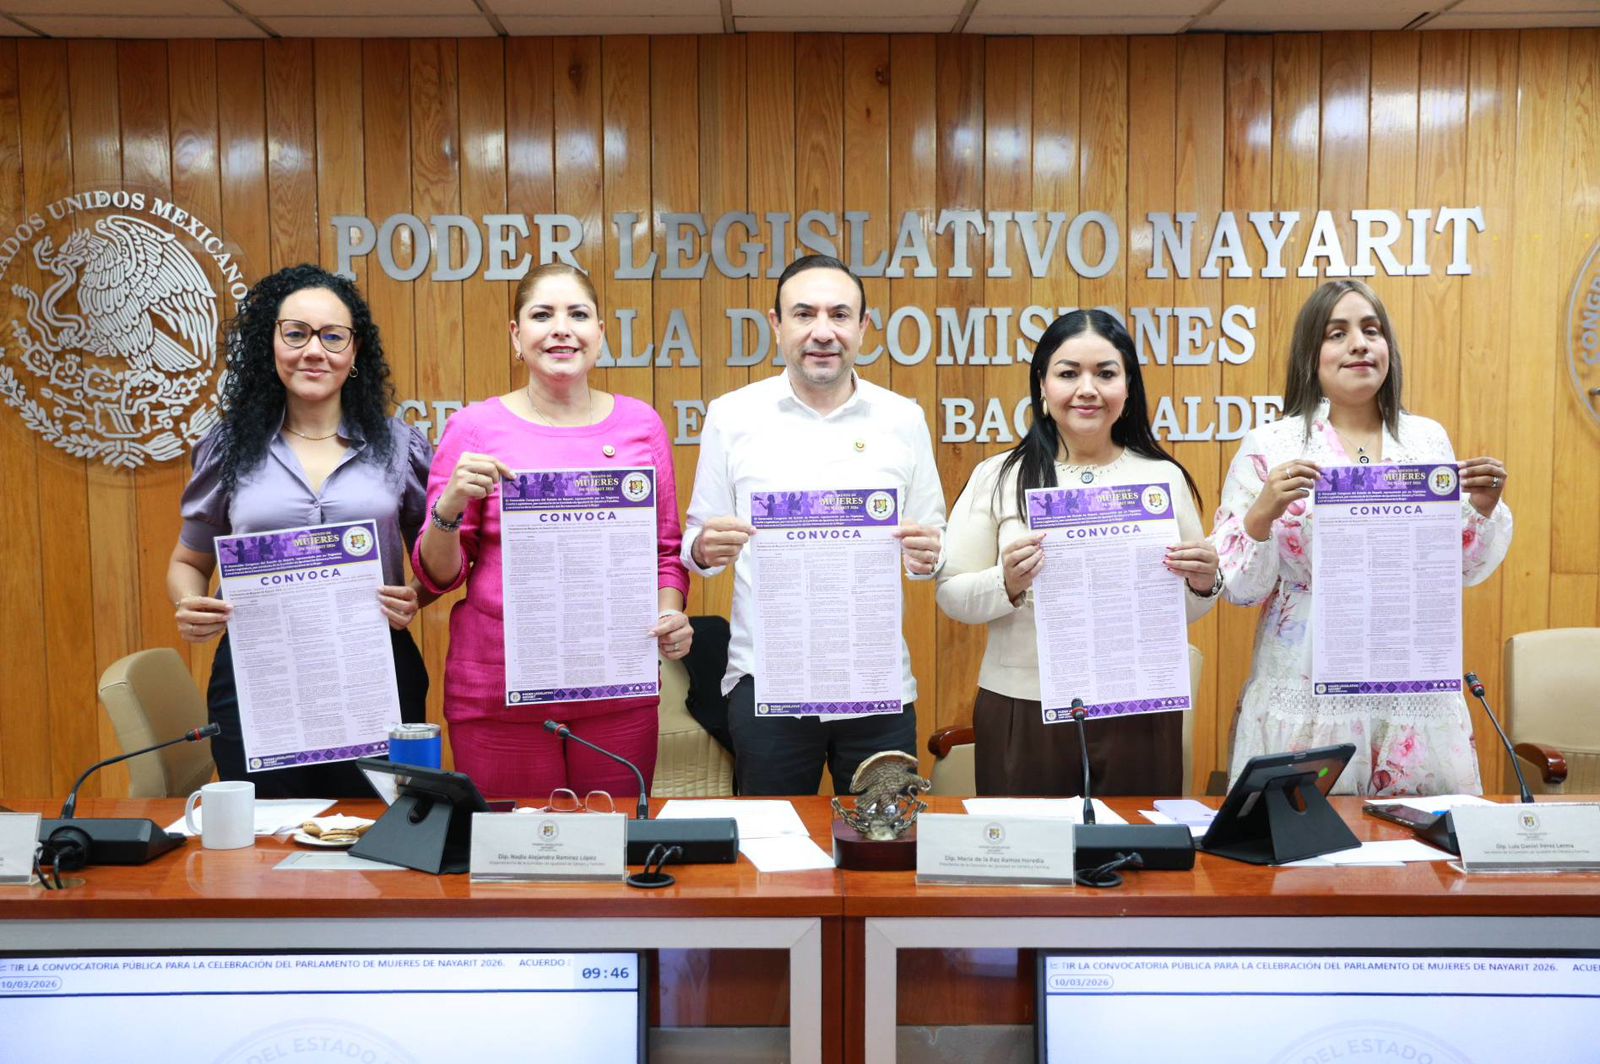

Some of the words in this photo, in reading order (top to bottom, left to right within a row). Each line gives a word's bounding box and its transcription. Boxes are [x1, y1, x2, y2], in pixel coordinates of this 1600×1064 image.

[330, 212, 588, 282] PODER
[613, 209, 1120, 280] LEGISLATIVO
[1146, 205, 1486, 280] NAYARIT
[0, 213, 46, 280] ADOS
[46, 190, 145, 220] UNIDOS
[150, 197, 249, 313] MEXICANO
[575, 477, 620, 487] MUJERES
[1383, 472, 1426, 481] MUJERES
[819, 497, 864, 506] MUJERES
[1350, 505, 1423, 516] CONVOCA
[539, 511, 617, 523] CONVOCA
[786, 529, 862, 541] CONVOCA
[1066, 524, 1142, 539] CONVOCA
[293, 534, 340, 548] MUJERES
[260, 567, 342, 586] CONVOCA
[27, 963, 39, 972] LA
[42, 961, 119, 972] CONVOCATORIA
[122, 959, 162, 971] PÚBLICA
[165, 961, 191, 970] PARA
[193, 961, 205, 970] LA
[208, 958, 273, 969] CELEBRACIÓN
[275, 960, 293, 969] DEL
[295, 959, 361, 969] PARLAMENTO
[363, 959, 376, 968] DE
[378, 959, 420, 969] MUJERES
[423, 959, 435, 968] DE
[438, 958, 478, 968] NAYARIT
[519, 958, 565, 967] ACUERDO
[1078, 961, 1090, 970] LA
[1093, 961, 1169, 970] CONVOCATORIA
[1171, 959, 1211, 970] PÚBLICA
[1214, 961, 1239, 970] PARA
[1241, 961, 1254, 970] LA
[1255, 959, 1321, 970] CELEBRACIÓN
[1324, 961, 1341, 970] DEL
[1344, 962, 1410, 971] PARLAMENTO
[1412, 962, 1425, 971] DE
[1427, 962, 1471, 972] MUJERES
[1473, 962, 1486, 971] DE
[1489, 963, 1530, 972] NAYARIT
[1572, 963, 1600, 972] ACUE
[582, 967, 629, 979] 09:46
[2, 980, 58, 989] 10/03/2026
[1055, 978, 1109, 987] 10/03/2026
[292, 1036, 378, 1064] ESTADO
[1346, 1038, 1434, 1064] ESTADO
